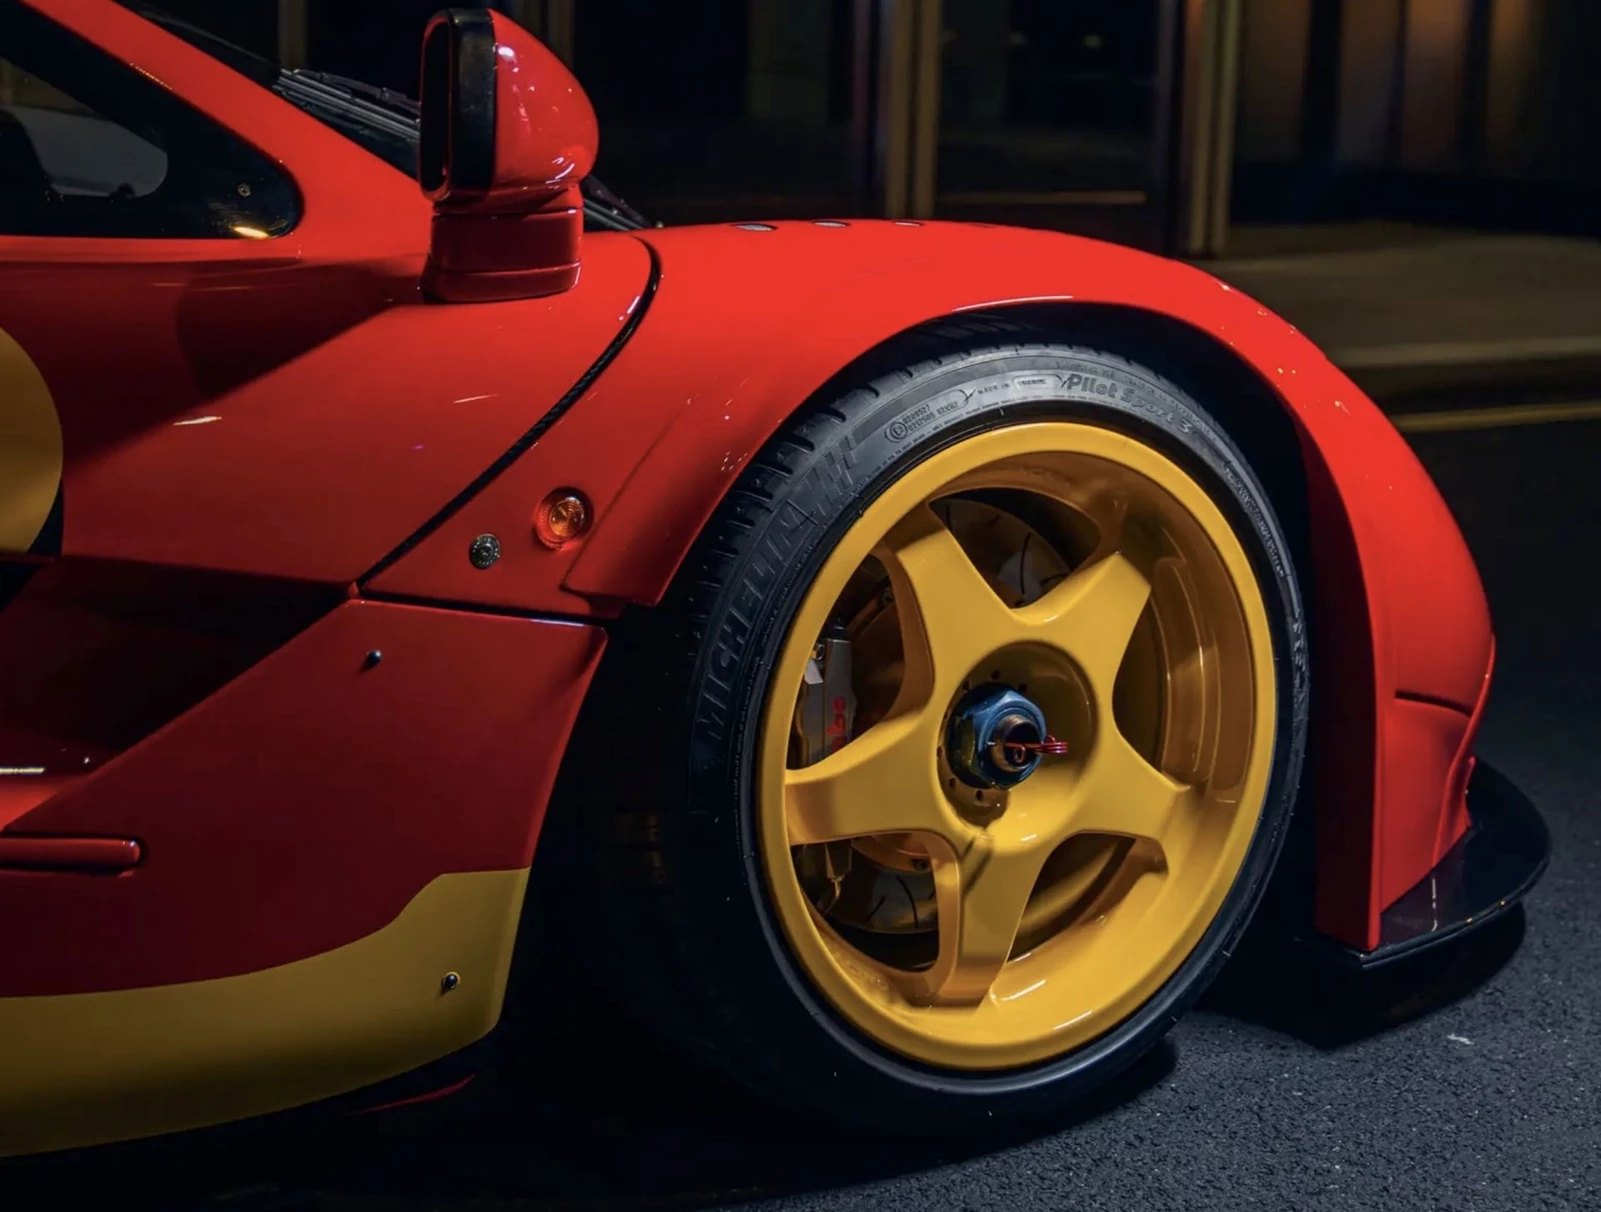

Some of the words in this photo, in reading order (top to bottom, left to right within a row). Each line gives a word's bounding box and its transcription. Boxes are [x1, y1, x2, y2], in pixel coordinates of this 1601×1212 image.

[1066, 373, 1118, 399] Pilot
[1120, 387, 1174, 423] Sport
[1177, 418, 1193, 434] 3
[695, 506, 804, 740] MICHELIN
